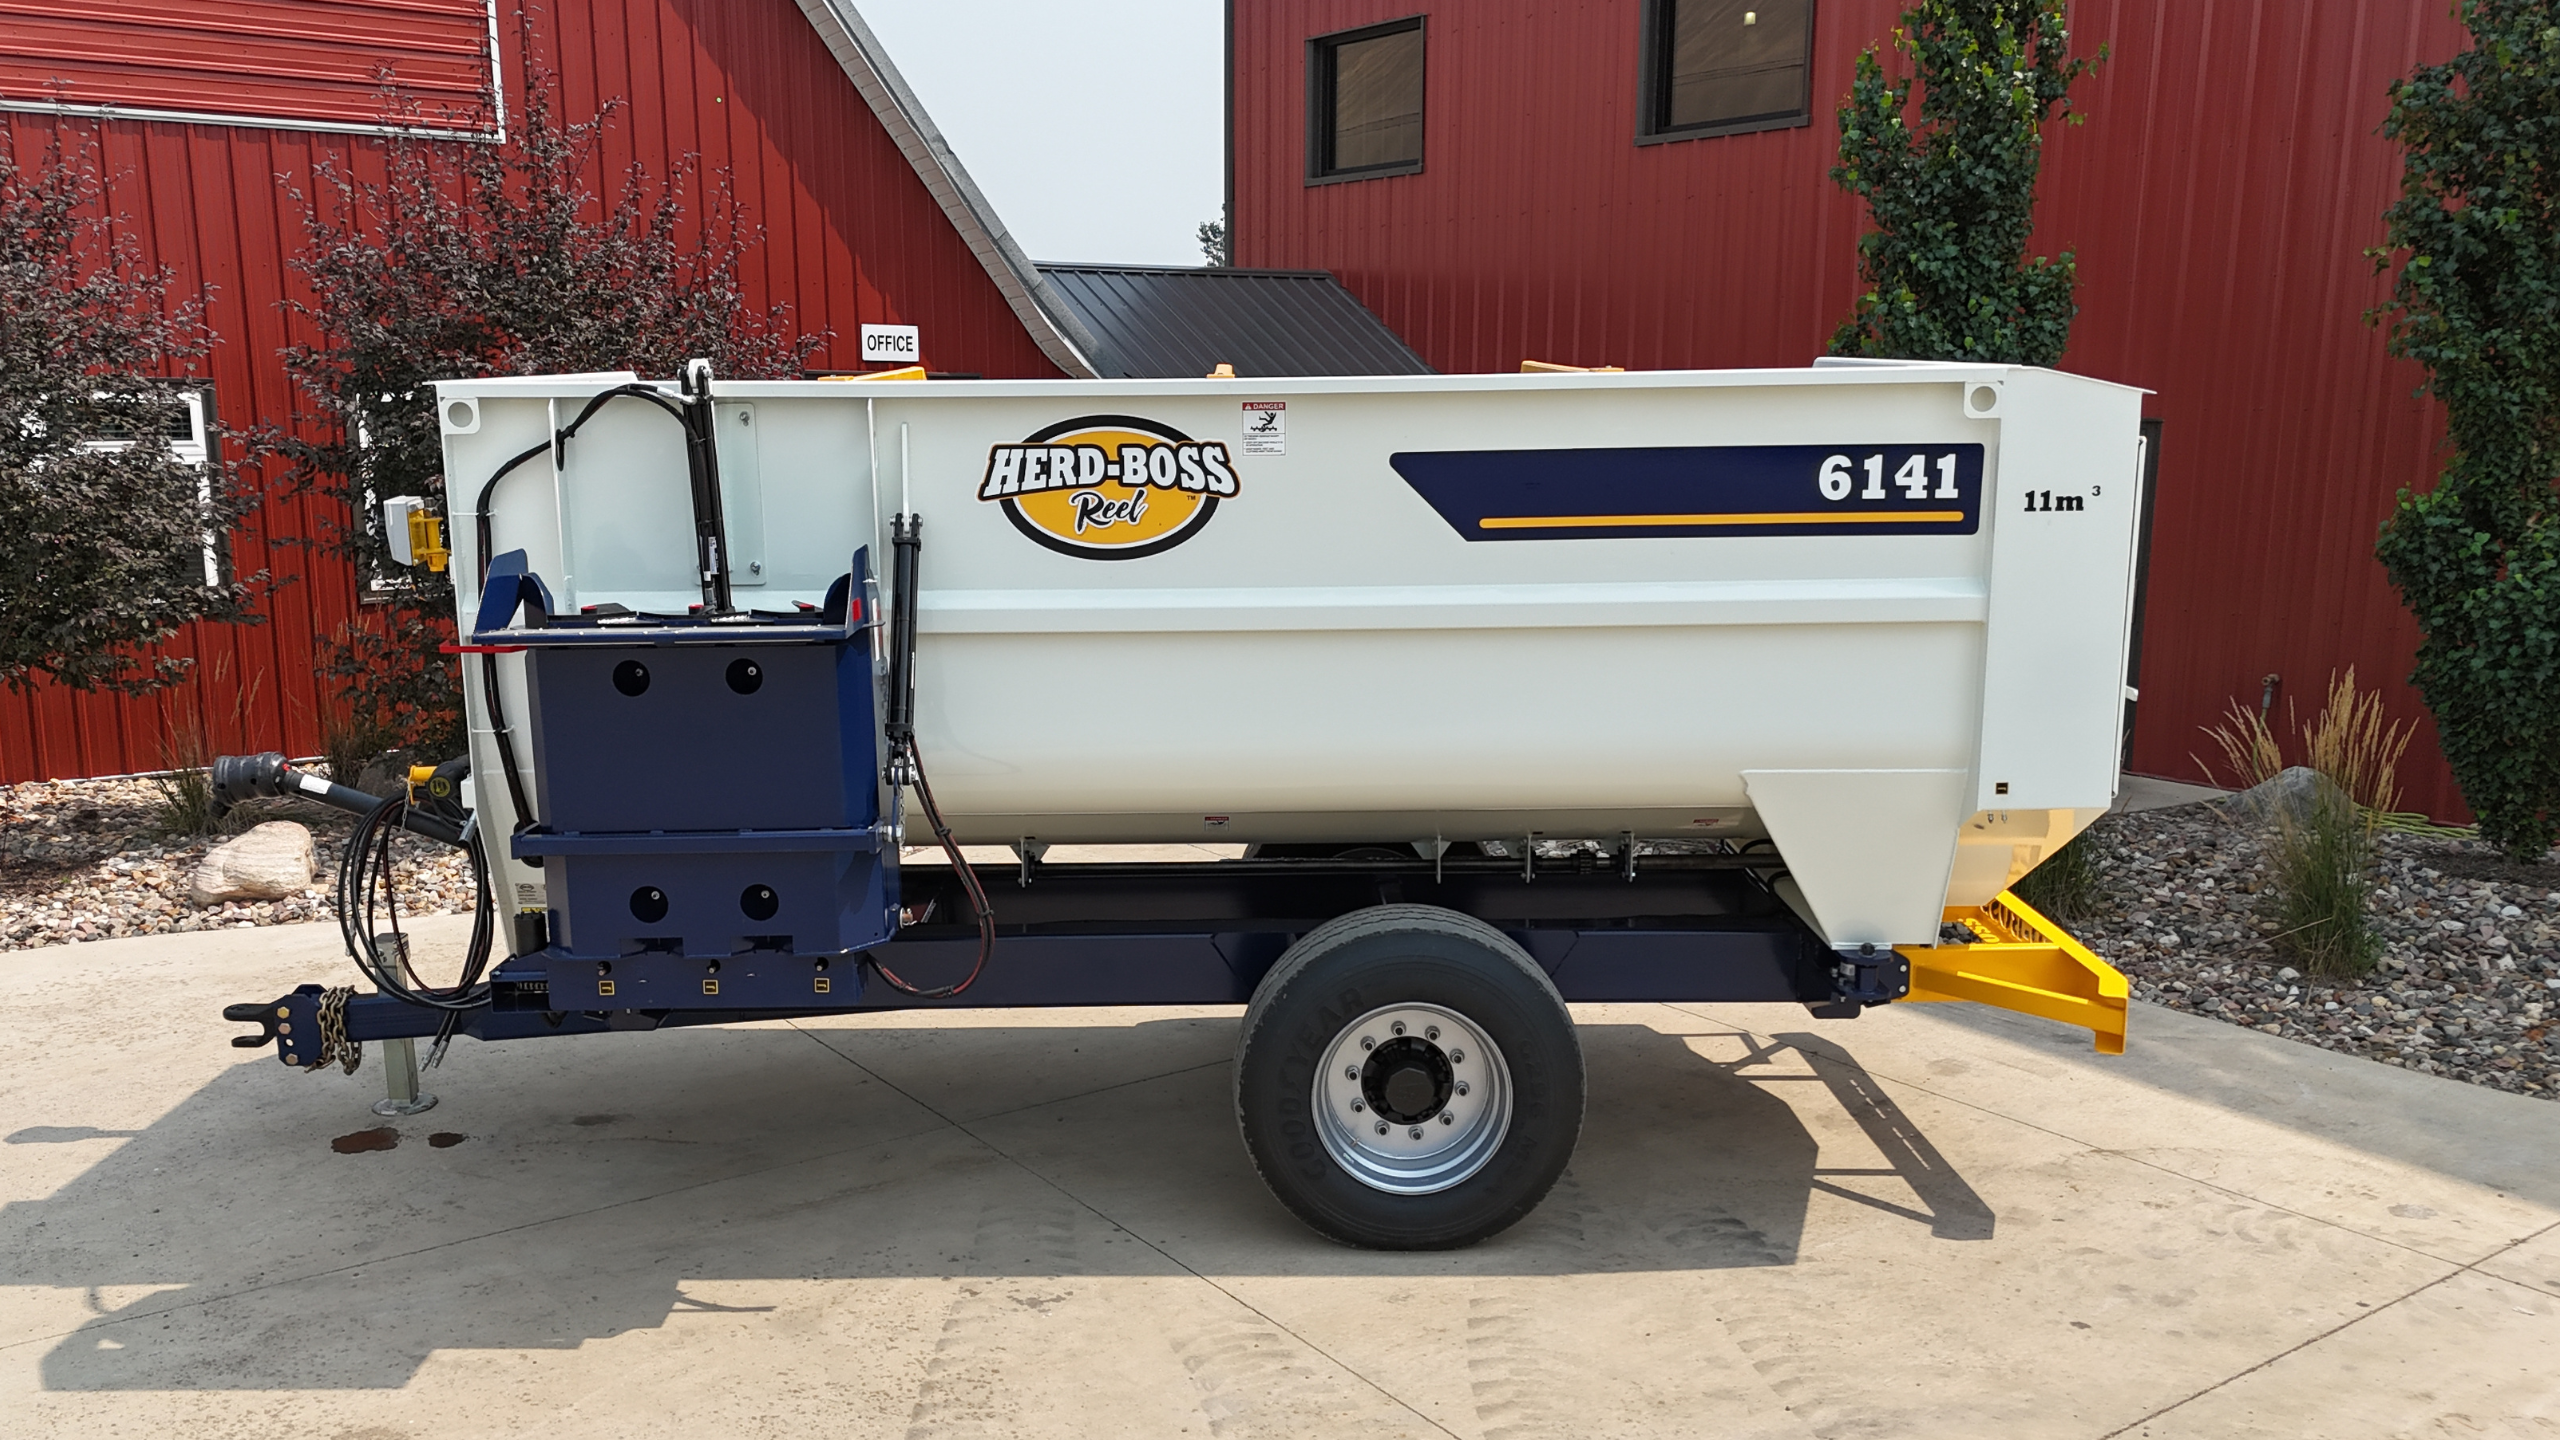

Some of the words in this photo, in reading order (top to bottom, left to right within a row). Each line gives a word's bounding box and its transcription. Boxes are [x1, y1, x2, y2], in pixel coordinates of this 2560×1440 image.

[867, 334, 914, 352] OFFICE
[981, 444, 1237, 499] HERD-BOSS
[1818, 453, 1959, 501] 6141
[1069, 488, 1148, 532] Reel
[2023, 490, 2084, 512] 11m
[2091, 485, 2101, 496] 3
[1278, 986, 1366, 1182] GOODYEAR
